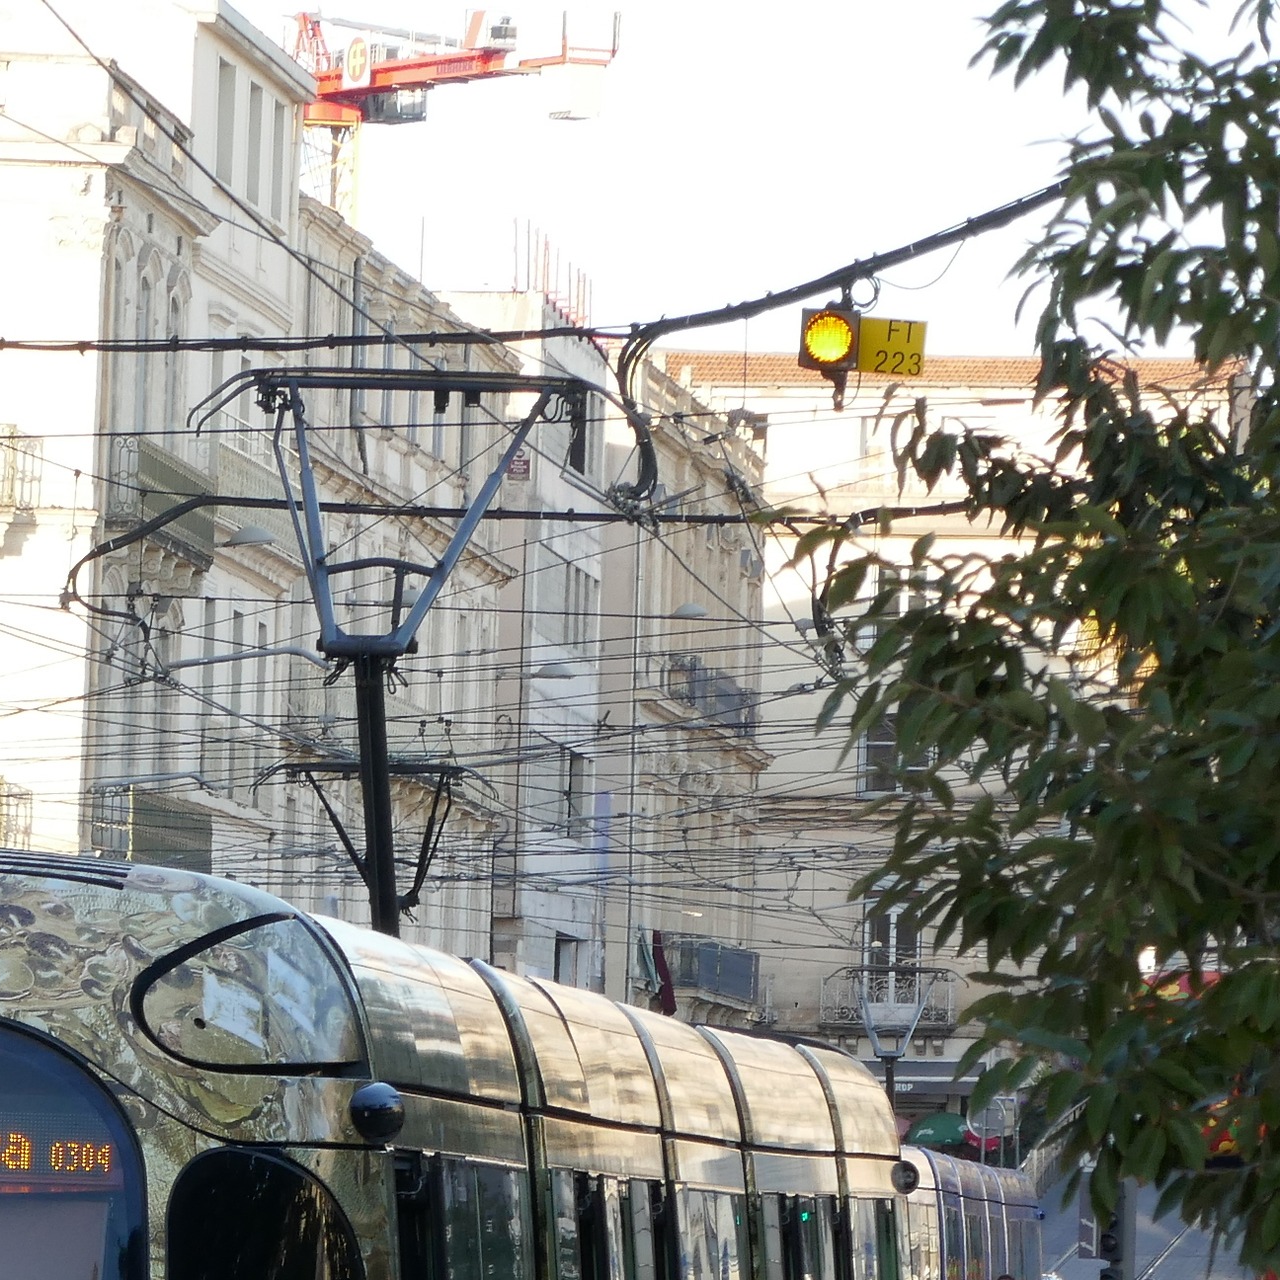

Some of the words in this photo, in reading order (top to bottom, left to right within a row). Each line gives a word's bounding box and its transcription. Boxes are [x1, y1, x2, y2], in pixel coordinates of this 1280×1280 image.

[887, 319, 918, 343] FT
[874, 350, 922, 376] 223
[50, 1140, 112, 1173] 0304
